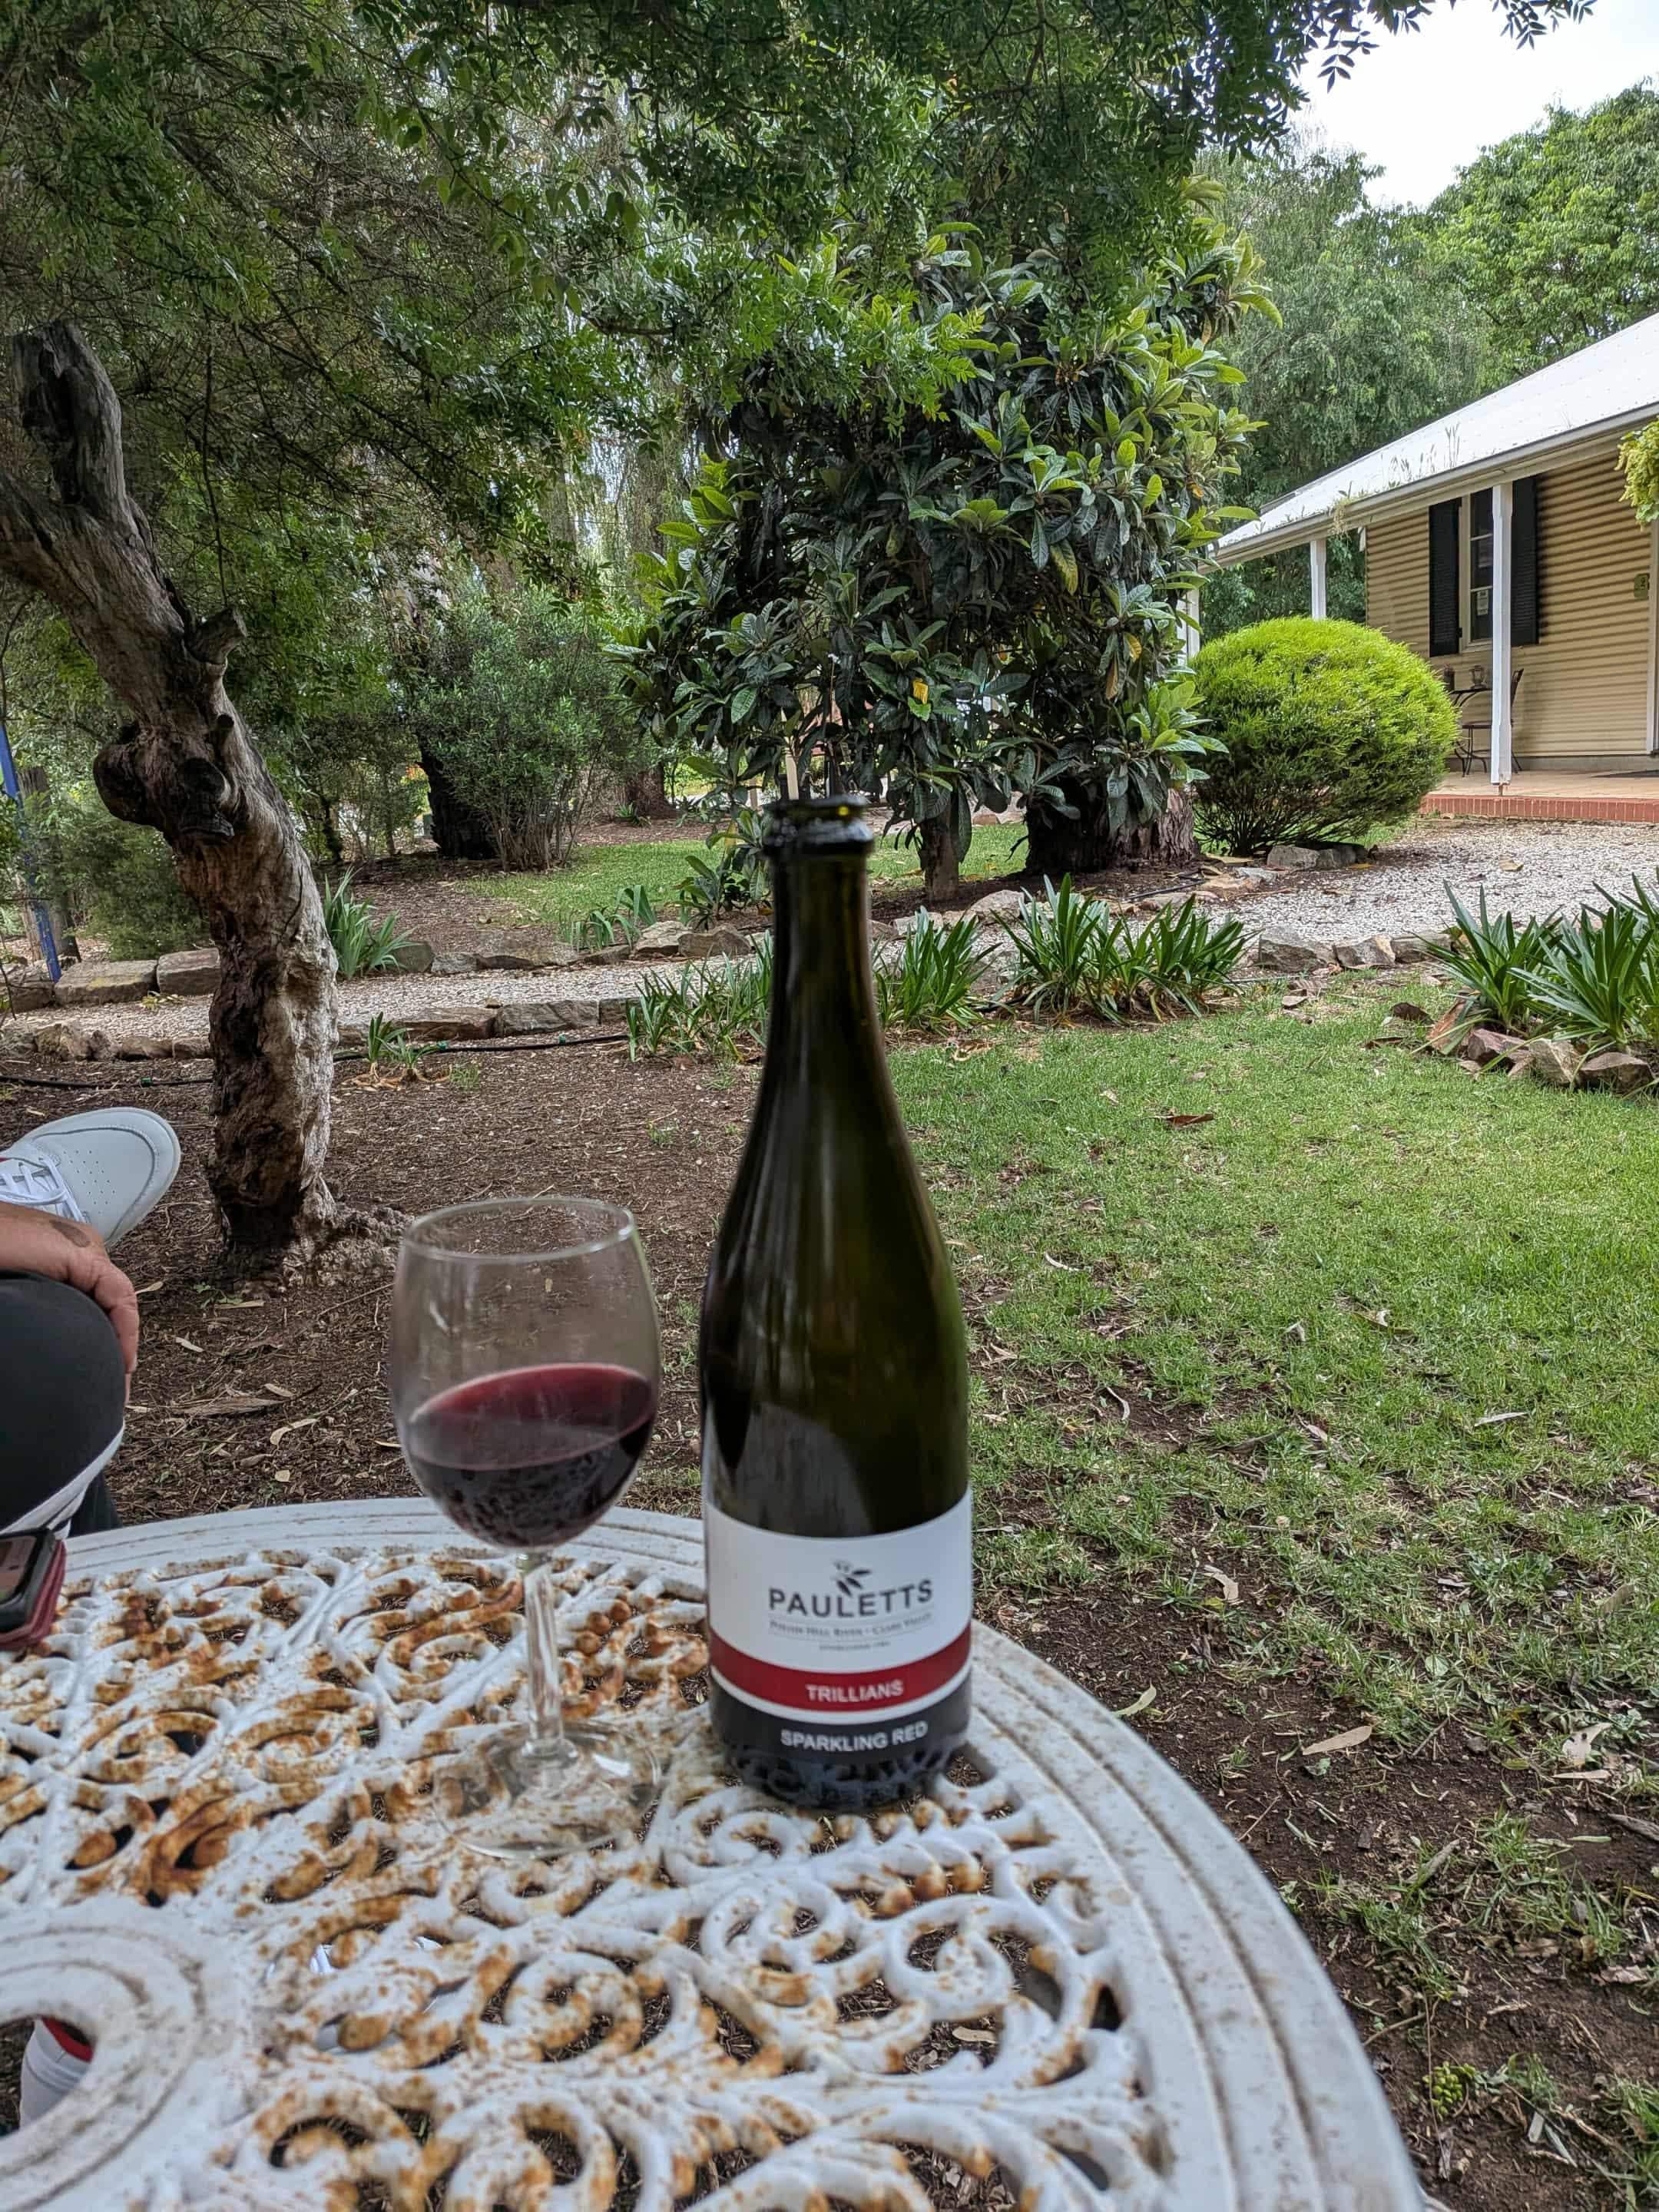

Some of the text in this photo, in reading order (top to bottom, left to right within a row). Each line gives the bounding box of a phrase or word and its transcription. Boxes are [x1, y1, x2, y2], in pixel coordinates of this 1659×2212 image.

[769, 1578, 932, 1618] PAULETTS
[806, 1679, 904, 1703] TRILLIANS
[780, 1720, 929, 1752] SPARKLING RED
